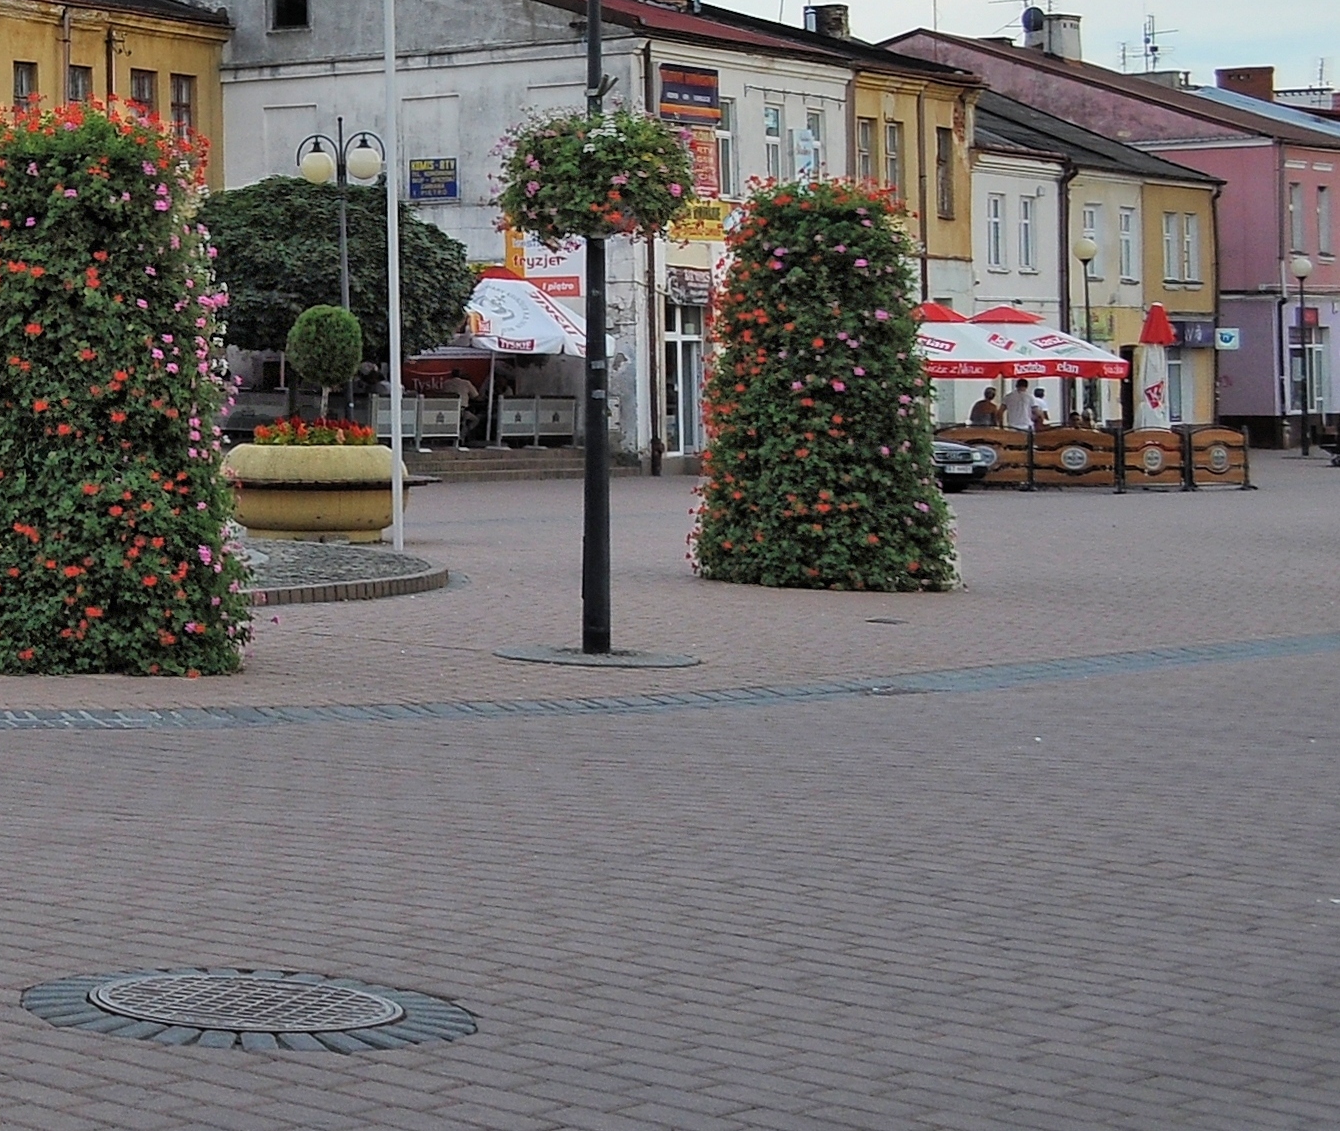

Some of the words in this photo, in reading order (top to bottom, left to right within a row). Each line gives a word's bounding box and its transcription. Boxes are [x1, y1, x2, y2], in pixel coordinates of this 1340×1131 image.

[513, 254, 567, 269] fryzjer
[547, 282, 575, 292] piętro
[500, 339, 532, 351] TYSKIE
[1056, 361, 1079, 374] elan
[411, 376, 444, 391] Tyski
